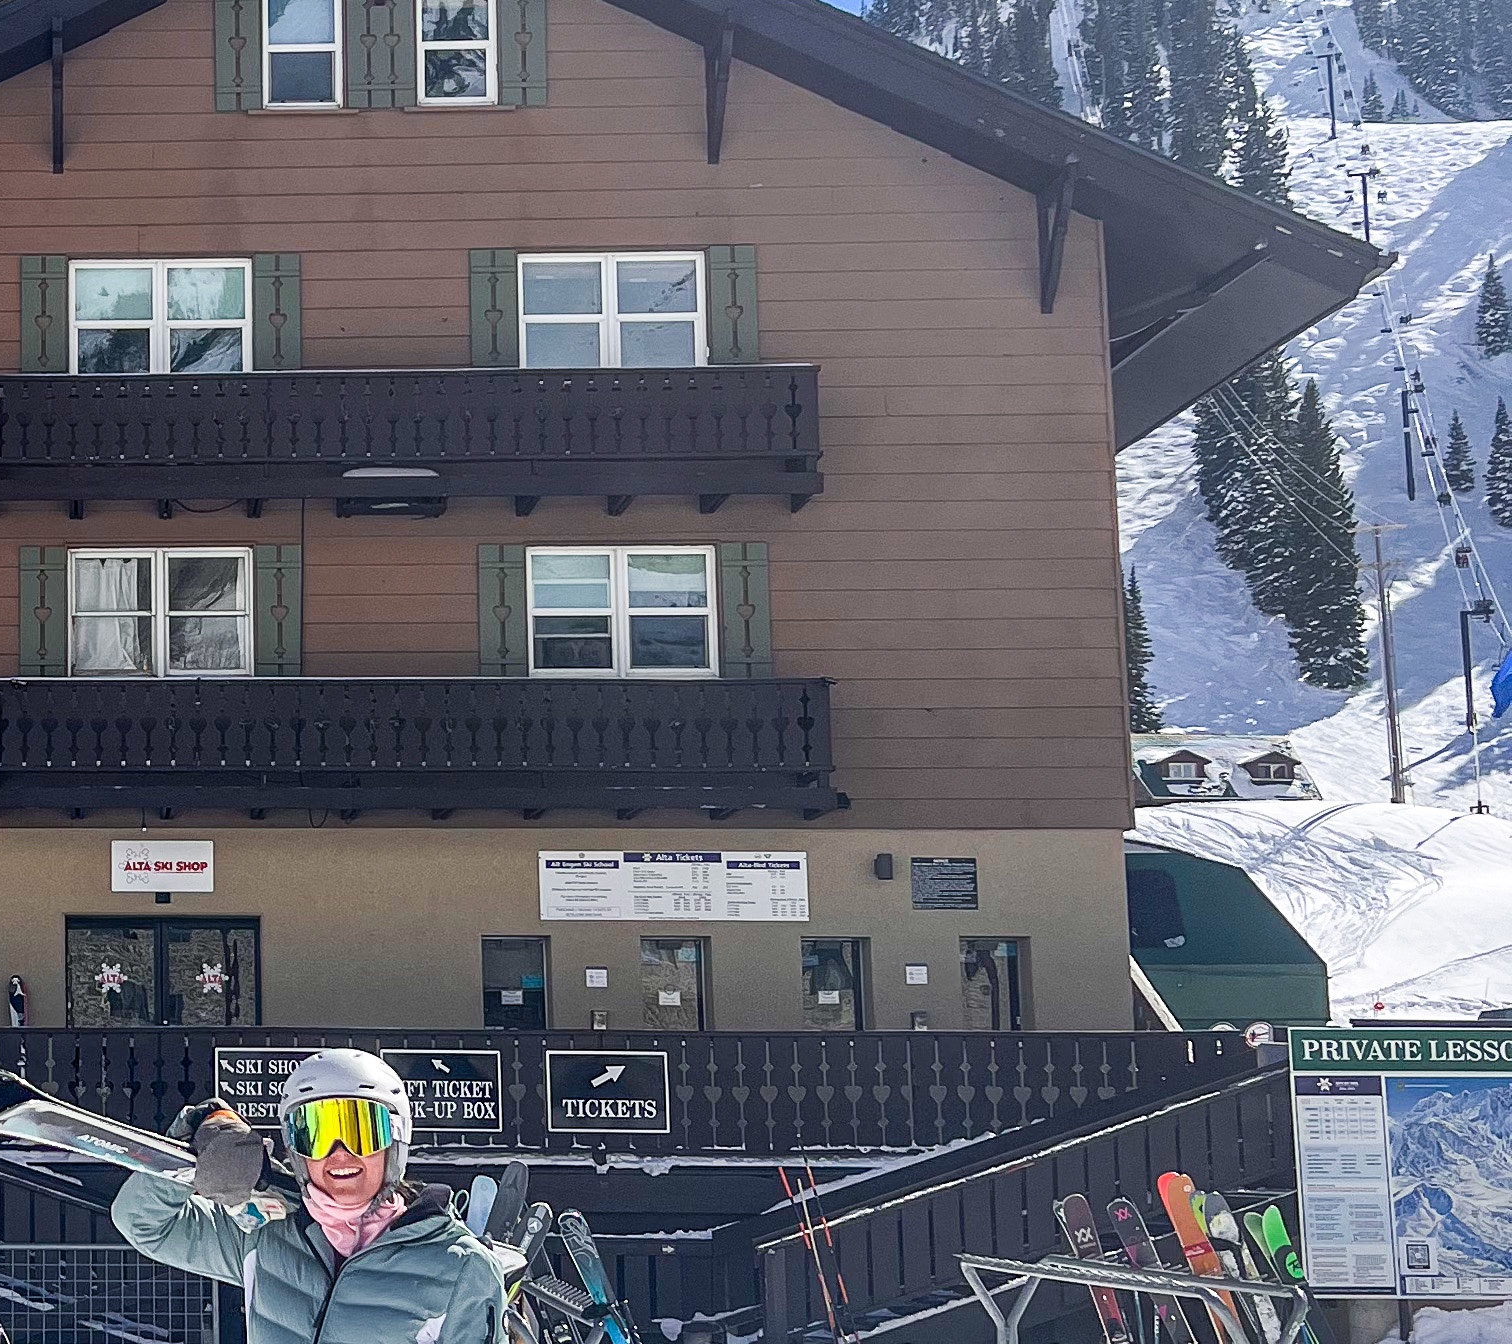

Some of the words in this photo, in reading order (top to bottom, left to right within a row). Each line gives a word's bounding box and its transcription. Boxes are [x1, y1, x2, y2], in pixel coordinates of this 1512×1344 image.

[124, 861, 152, 872] ALTA
[154, 861, 173, 871] SKI
[176, 861, 208, 872] SHOP
[100, 973, 123, 984] ALTA
[201, 973, 223, 984] ALTA
[1301, 1039, 1422, 1061] PRIVATE
[235, 1059, 263, 1074] SKI
[268, 1059, 302, 1075] SHO
[236, 1081, 263, 1096] SKI
[402, 1080, 427, 1098] FT
[432, 1080, 493, 1098] TICKET
[236, 1102, 280, 1118] REST
[463, 1101, 496, 1119] BOX
[562, 1099, 657, 1119] TICKETS
